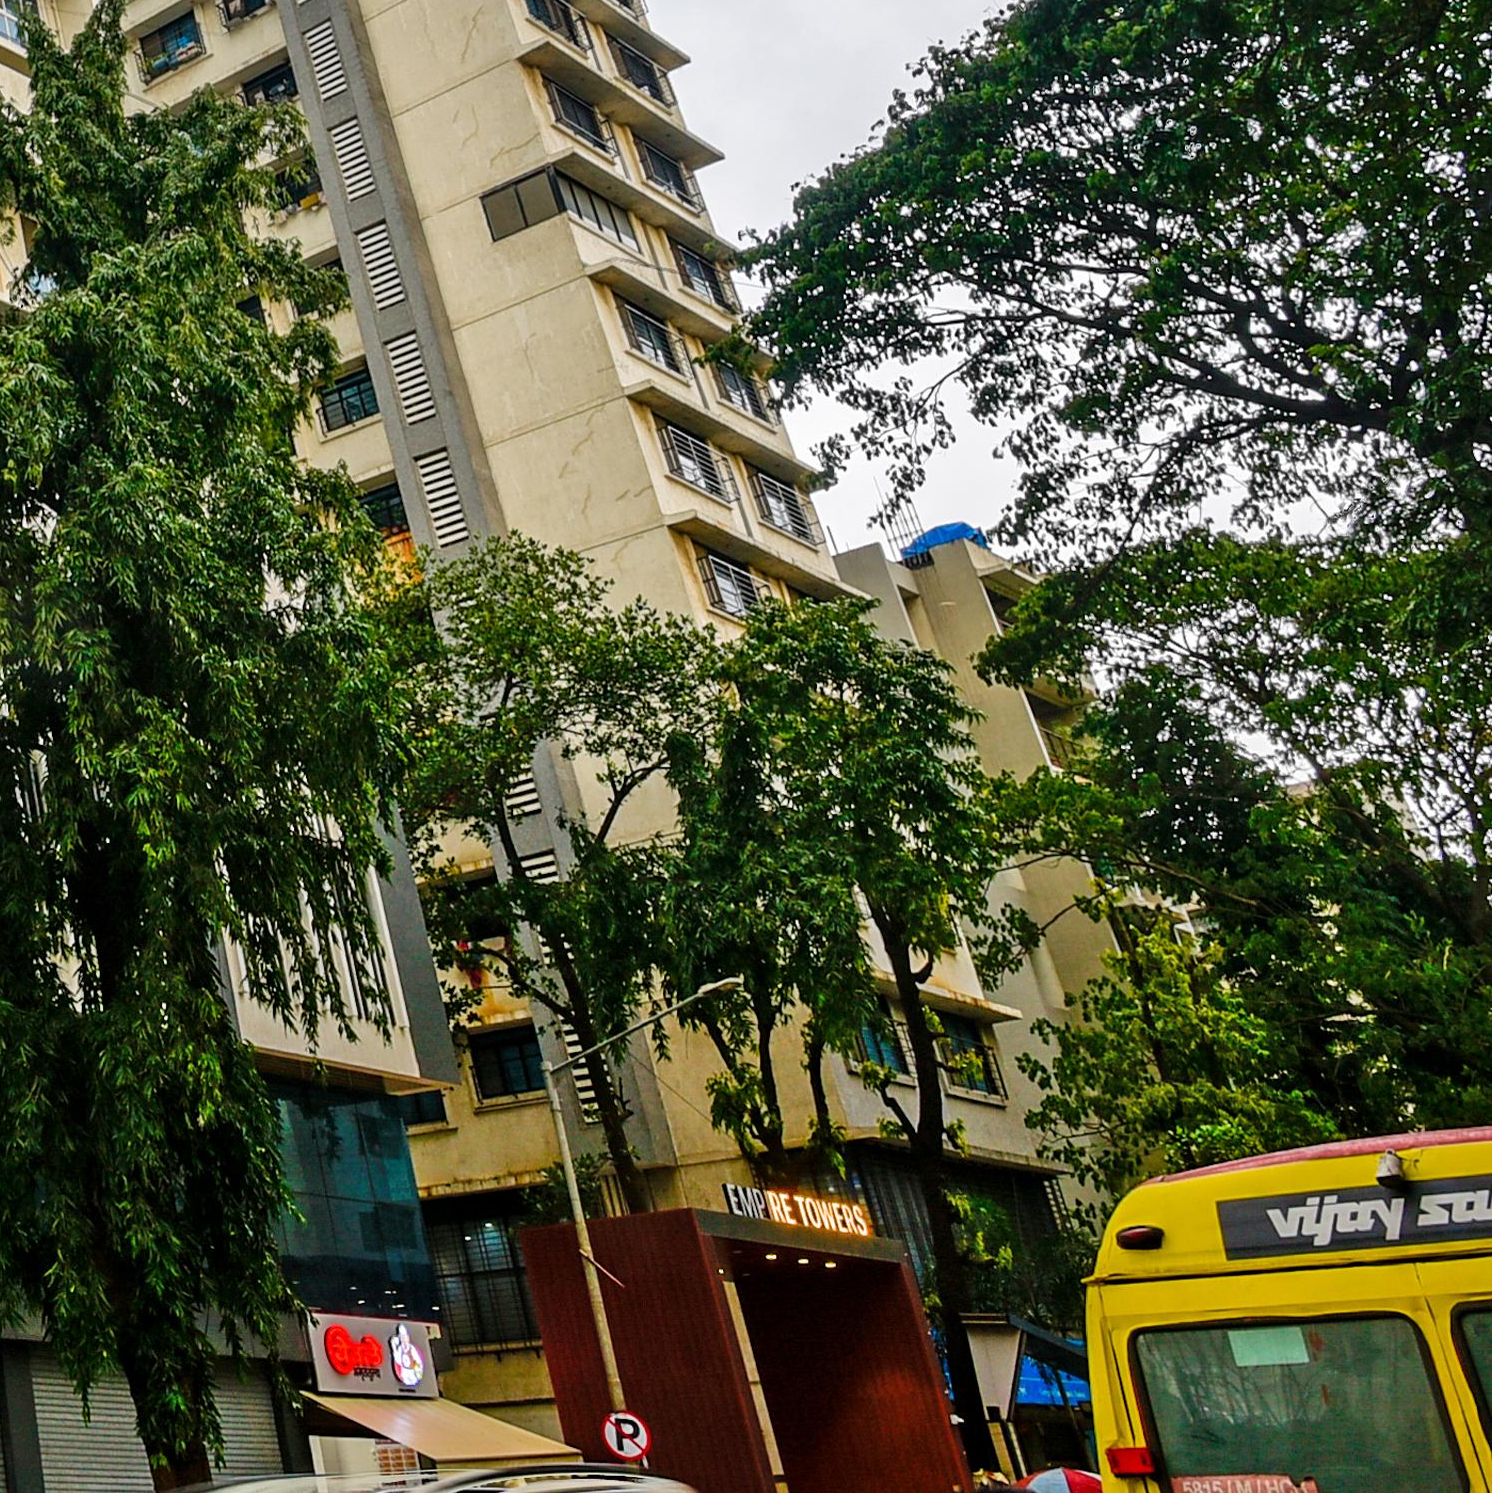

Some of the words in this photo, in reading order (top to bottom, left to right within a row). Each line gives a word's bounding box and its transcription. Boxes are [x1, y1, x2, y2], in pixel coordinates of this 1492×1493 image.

[723, 1183, 798, 1225] EMPIRE
[793, 1195, 868, 1237] TOWERS
[1266, 1195, 1405, 1247] vijay
[1417, 1189, 1492, 1227] sa
[615, 1418, 640, 1452] P
